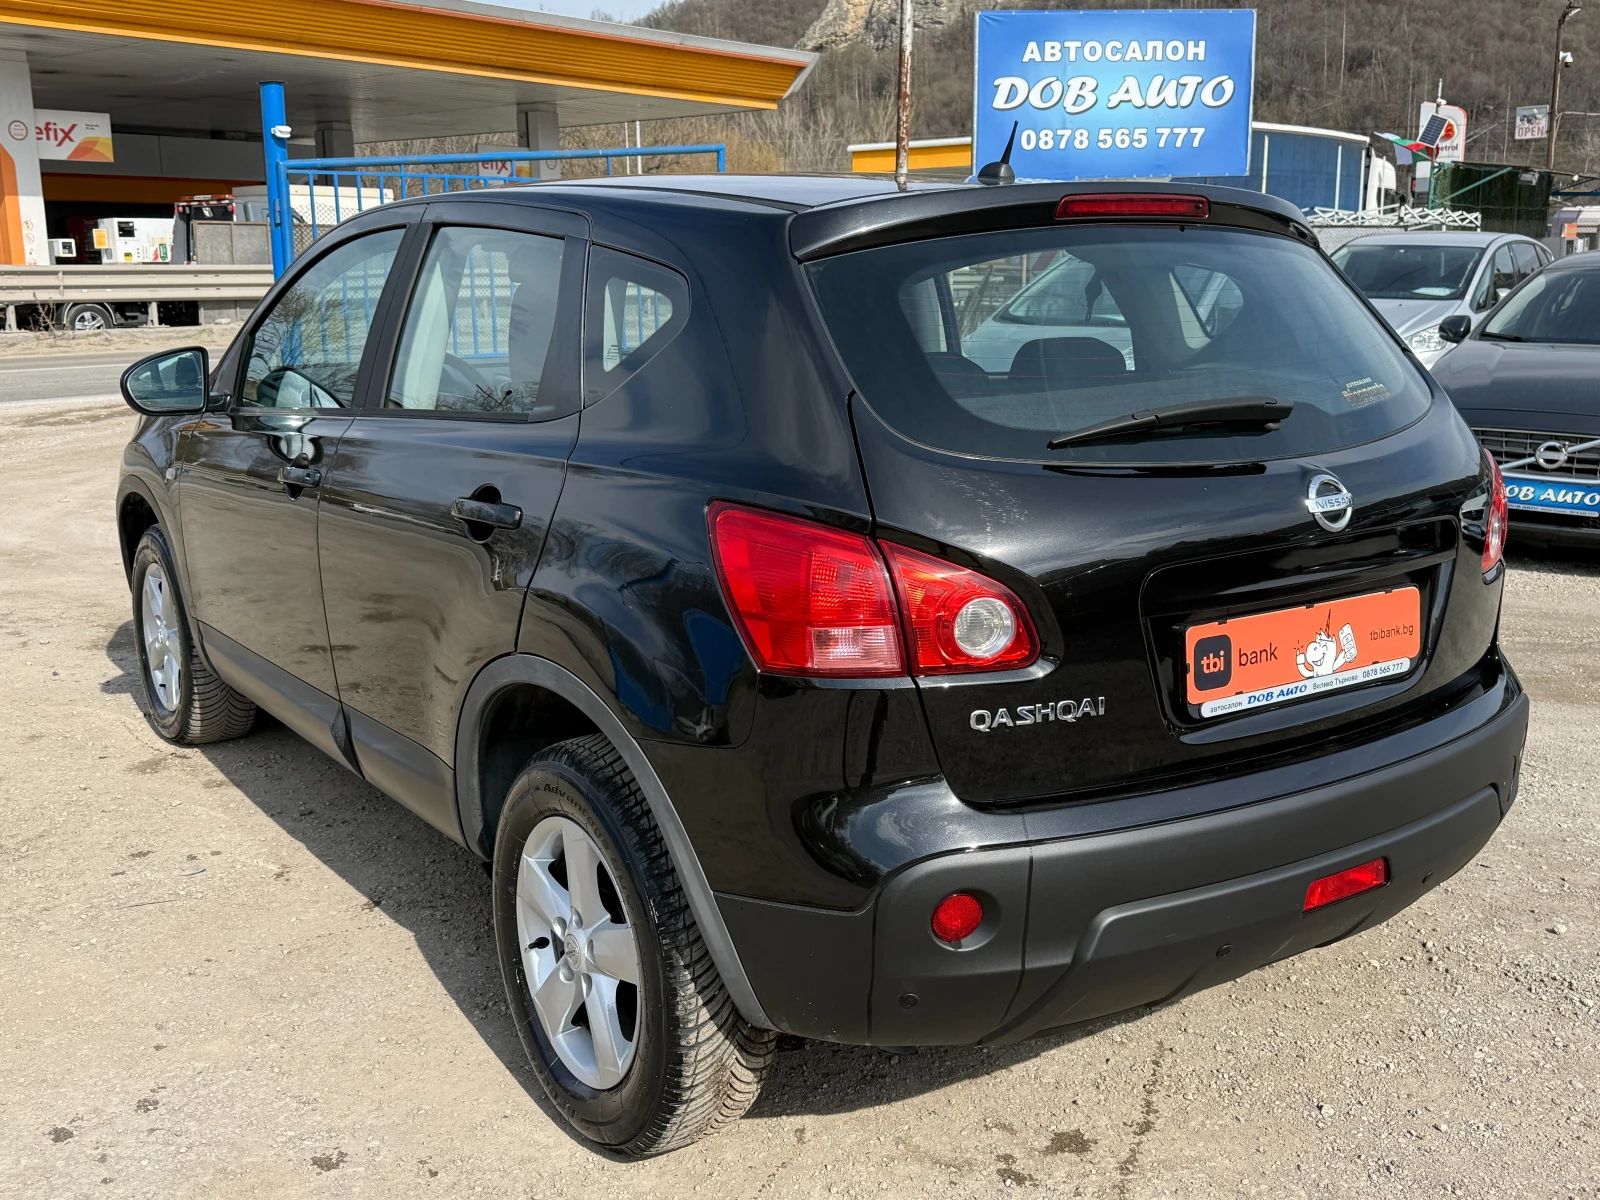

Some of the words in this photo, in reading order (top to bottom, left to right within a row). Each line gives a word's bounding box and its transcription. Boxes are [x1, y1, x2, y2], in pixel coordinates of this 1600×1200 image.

[1021, 40, 1206, 63] АВТОСАЛОН
[992, 76, 1098, 114] DOB
[1107, 75, 1235, 108] AUTO
[1021, 128, 1089, 151] 0878
[1097, 127, 1148, 150] 565
[1155, 127, 1206, 149] 777
[1517, 126, 1545, 138] OPEN
[1315, 496, 1353, 510] NISSAN
[1505, 484, 1536, 501] OB
[1539, 486, 1600, 506] AUTO
[1370, 624, 1414, 642] tbibank.bg
[1201, 651, 1225, 675] tbi
[1238, 642, 1278, 667] bank
[1209, 701, 1243, 714] автосалон
[1247, 692, 1274, 705] DOB
[1276, 684, 1307, 699] AUTO
[1312, 680, 1334, 691] Велико
[1334, 674, 1358, 689] Търново
[1362, 668, 1378, 679] 0878
[1378, 665, 1391, 676] 565
[1392, 662, 1404, 672] 777
[969, 696, 1106, 732] QASHQAI
